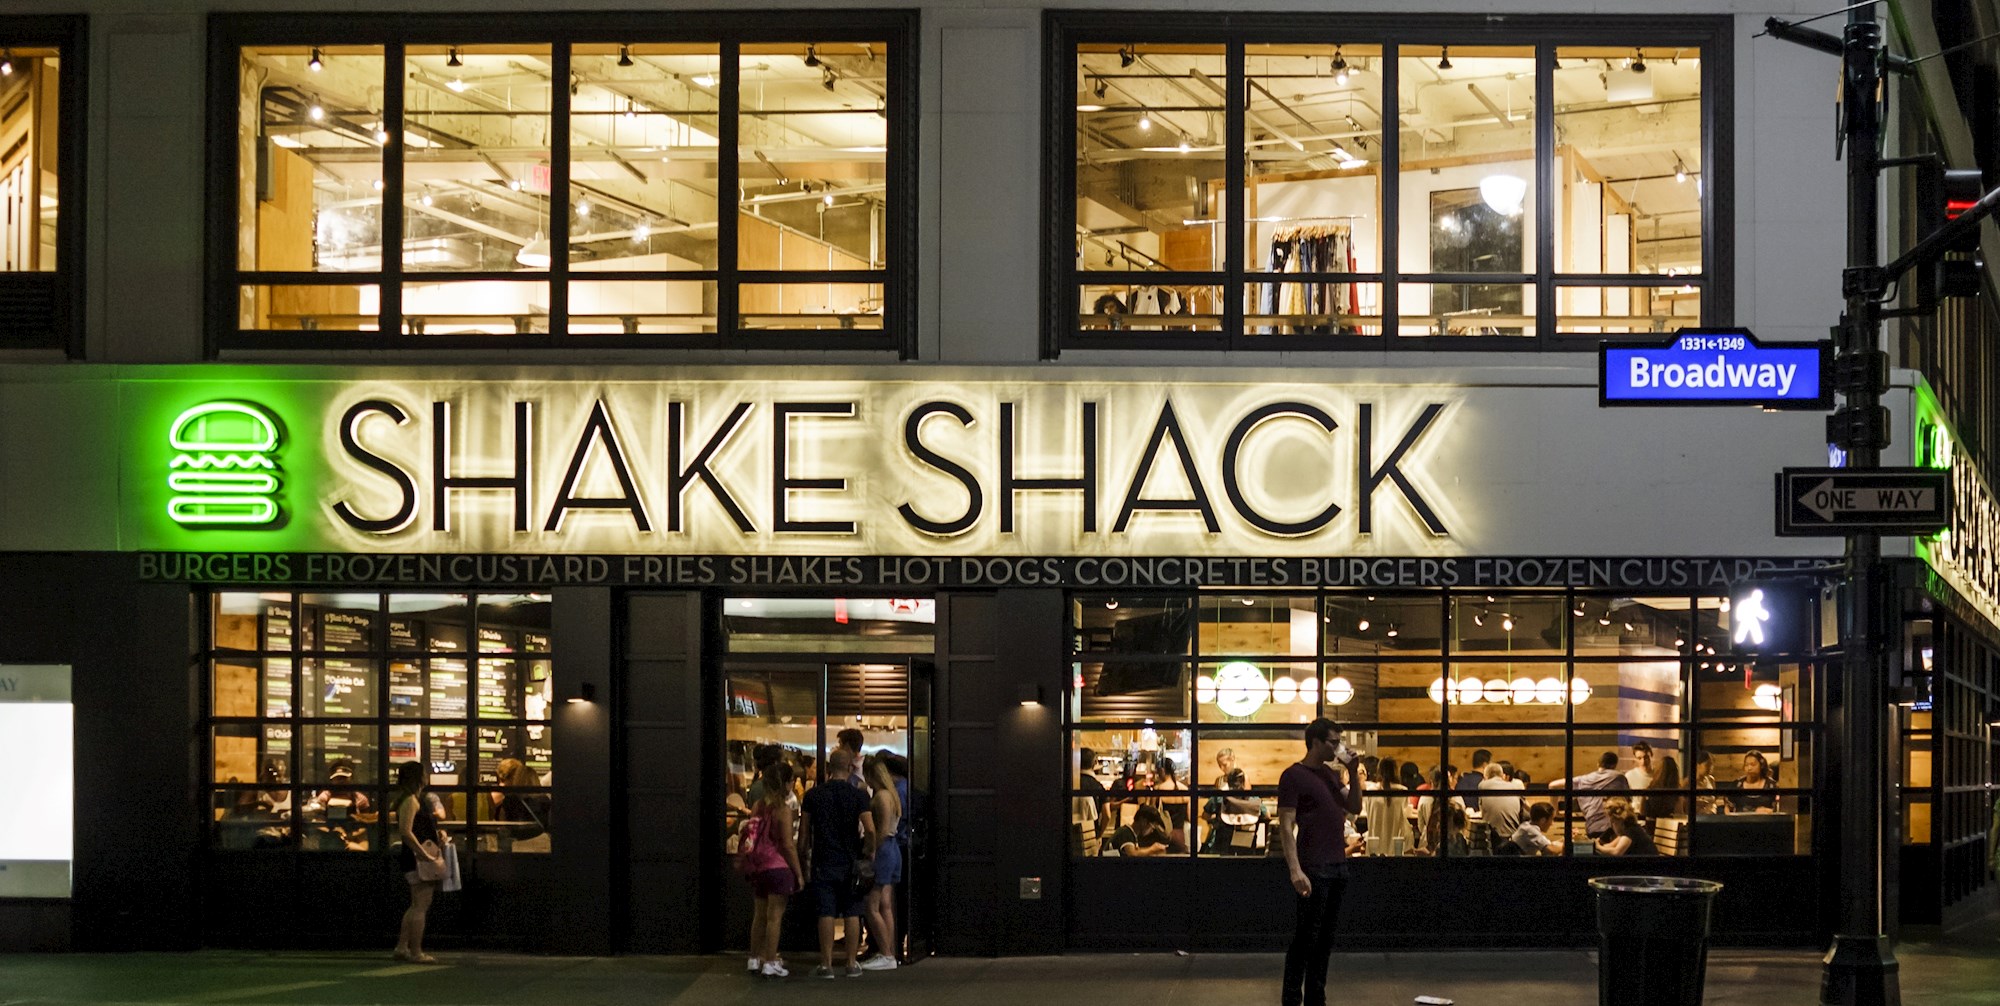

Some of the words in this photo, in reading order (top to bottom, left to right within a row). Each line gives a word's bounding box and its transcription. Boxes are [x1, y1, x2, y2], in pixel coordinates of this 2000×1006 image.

[1680, 337, 1707, 350] 1331
[1716, 337, 1745, 350] 1349
[1630, 355, 1797, 396] Broadway
[333, 398, 856, 534] SHAKE
[898, 399, 1449, 536] SHACK
[1815, 490, 1857, 510] ONE
[1878, 490, 1924, 509] WAY
[139, 553, 292, 580] BURGERS
[307, 554, 442, 581] FROZEN
[450, 555, 609, 583] CUSTARD
[624, 556, 716, 583] FRIES
[730, 556, 864, 584] SHAKES
[879, 557, 952, 584] HOT
[961, 557, 1061, 584] DOGS
[1074, 558, 1290, 586] CONCRETES
[1302, 558, 1460, 586] BURGERS
[1475, 558, 1611, 586] FROZEN
